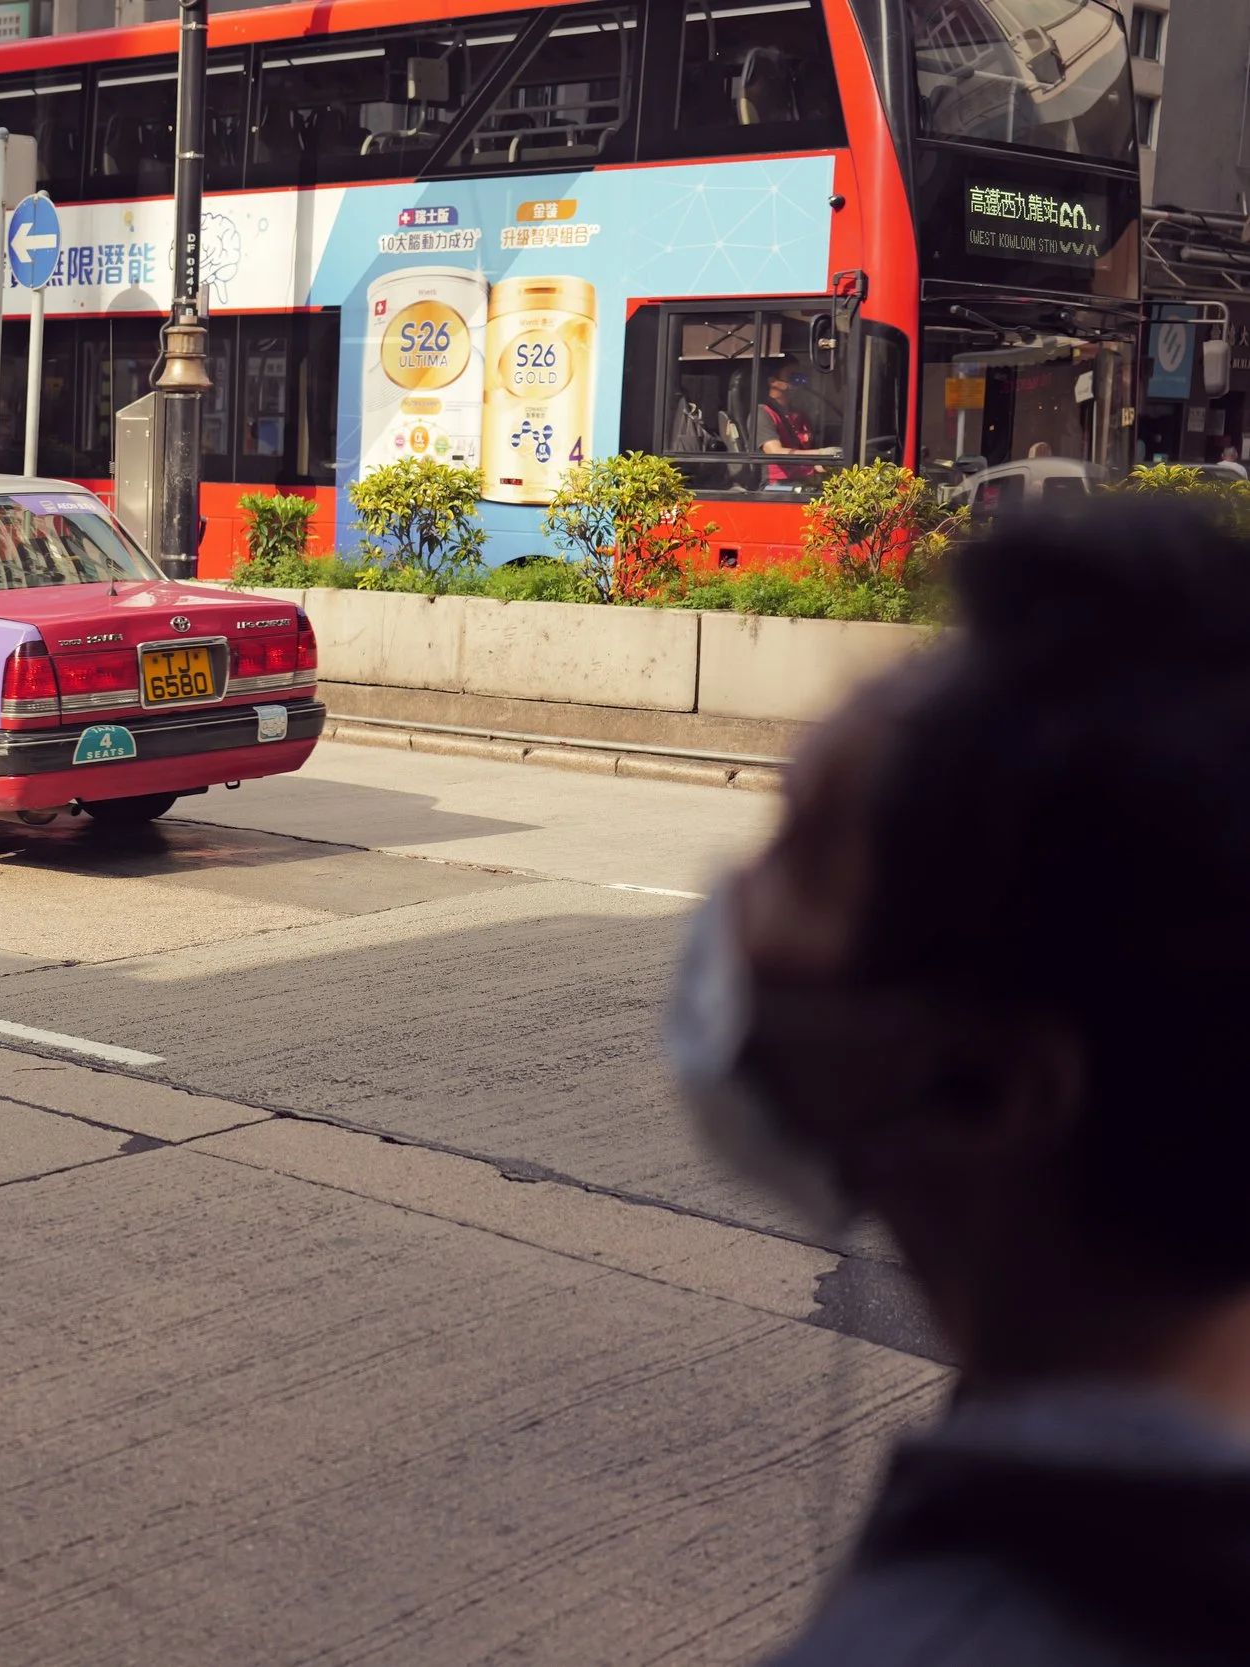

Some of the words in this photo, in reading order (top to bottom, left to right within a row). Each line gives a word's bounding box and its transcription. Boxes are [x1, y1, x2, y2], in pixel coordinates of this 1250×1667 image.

[533, 202, 559, 219] 金裝
[969, 186, 1058, 224] 高鐵西九龍站
[414, 208, 450, 225] 瑞士版
[969, 229, 997, 246] (WEST
[999, 233, 1036, 251] KOWLOON
[400, 321, 451, 353] S-26
[399, 354, 449, 368] ULTIMA
[516, 343, 557, 368] S-26
[514, 371, 558, 384] GOLD
[569, 436, 585, 467] 4
[161, 651, 191, 675] TJ
[151, 671, 208, 699] 6580
[99, 732, 112, 749] 4
[86, 746, 125, 760] SEATS
